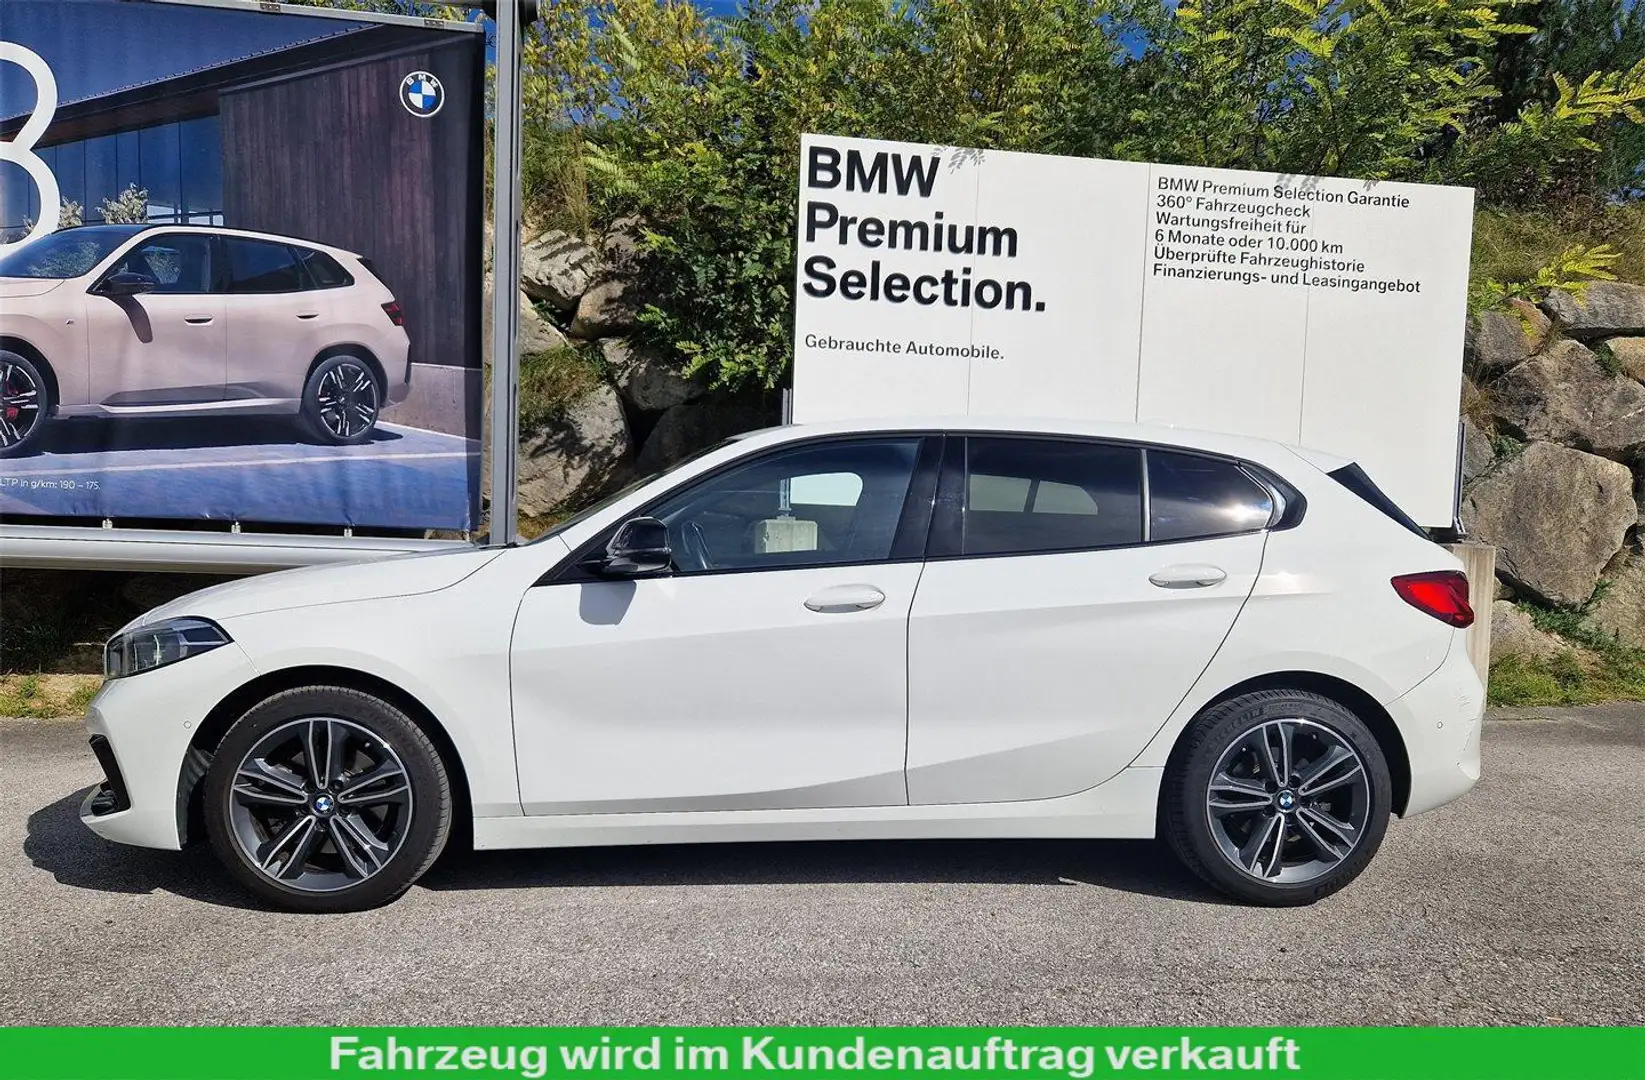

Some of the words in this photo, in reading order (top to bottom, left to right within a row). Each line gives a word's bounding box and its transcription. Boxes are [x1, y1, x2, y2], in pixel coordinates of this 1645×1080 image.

[807, 146, 941, 198] BMW
[1157, 194, 1192, 209] 360°
[1196, 197, 1310, 218] Fahrzeugcheck
[1158, 177, 1199, 192] BMW
[1203, 180, 1269, 197] Premium
[1273, 185, 1343, 203] Selection
[1347, 191, 1409, 208] Garantie
[806, 201, 1018, 257] Premium
[1156, 211, 1282, 233] Wartungsfreiheit
[1286, 220, 1306, 234] für
[1155, 229, 1164, 243] 6
[1168, 229, 1225, 246] Monate
[1228, 235, 1263, 248] oder
[1268, 237, 1318, 252] 10.000
[1321, 240, 1343, 254] km
[1154, 243, 1236, 264] Überprüfte
[1240, 252, 1364, 273] Fahrzeughistorie
[802, 255, 1046, 312] Selection.
[1153, 263, 1267, 285] Finanzierungs-
[1271, 272, 1299, 285] und
[1303, 273, 1421, 294] Leasingangebot
[805, 334, 901, 354] Gebrauchte
[905, 340, 1004, 360] Automobile.
[31, 480, 57, 489] g/km:
[60, 480, 75, 489] 190
